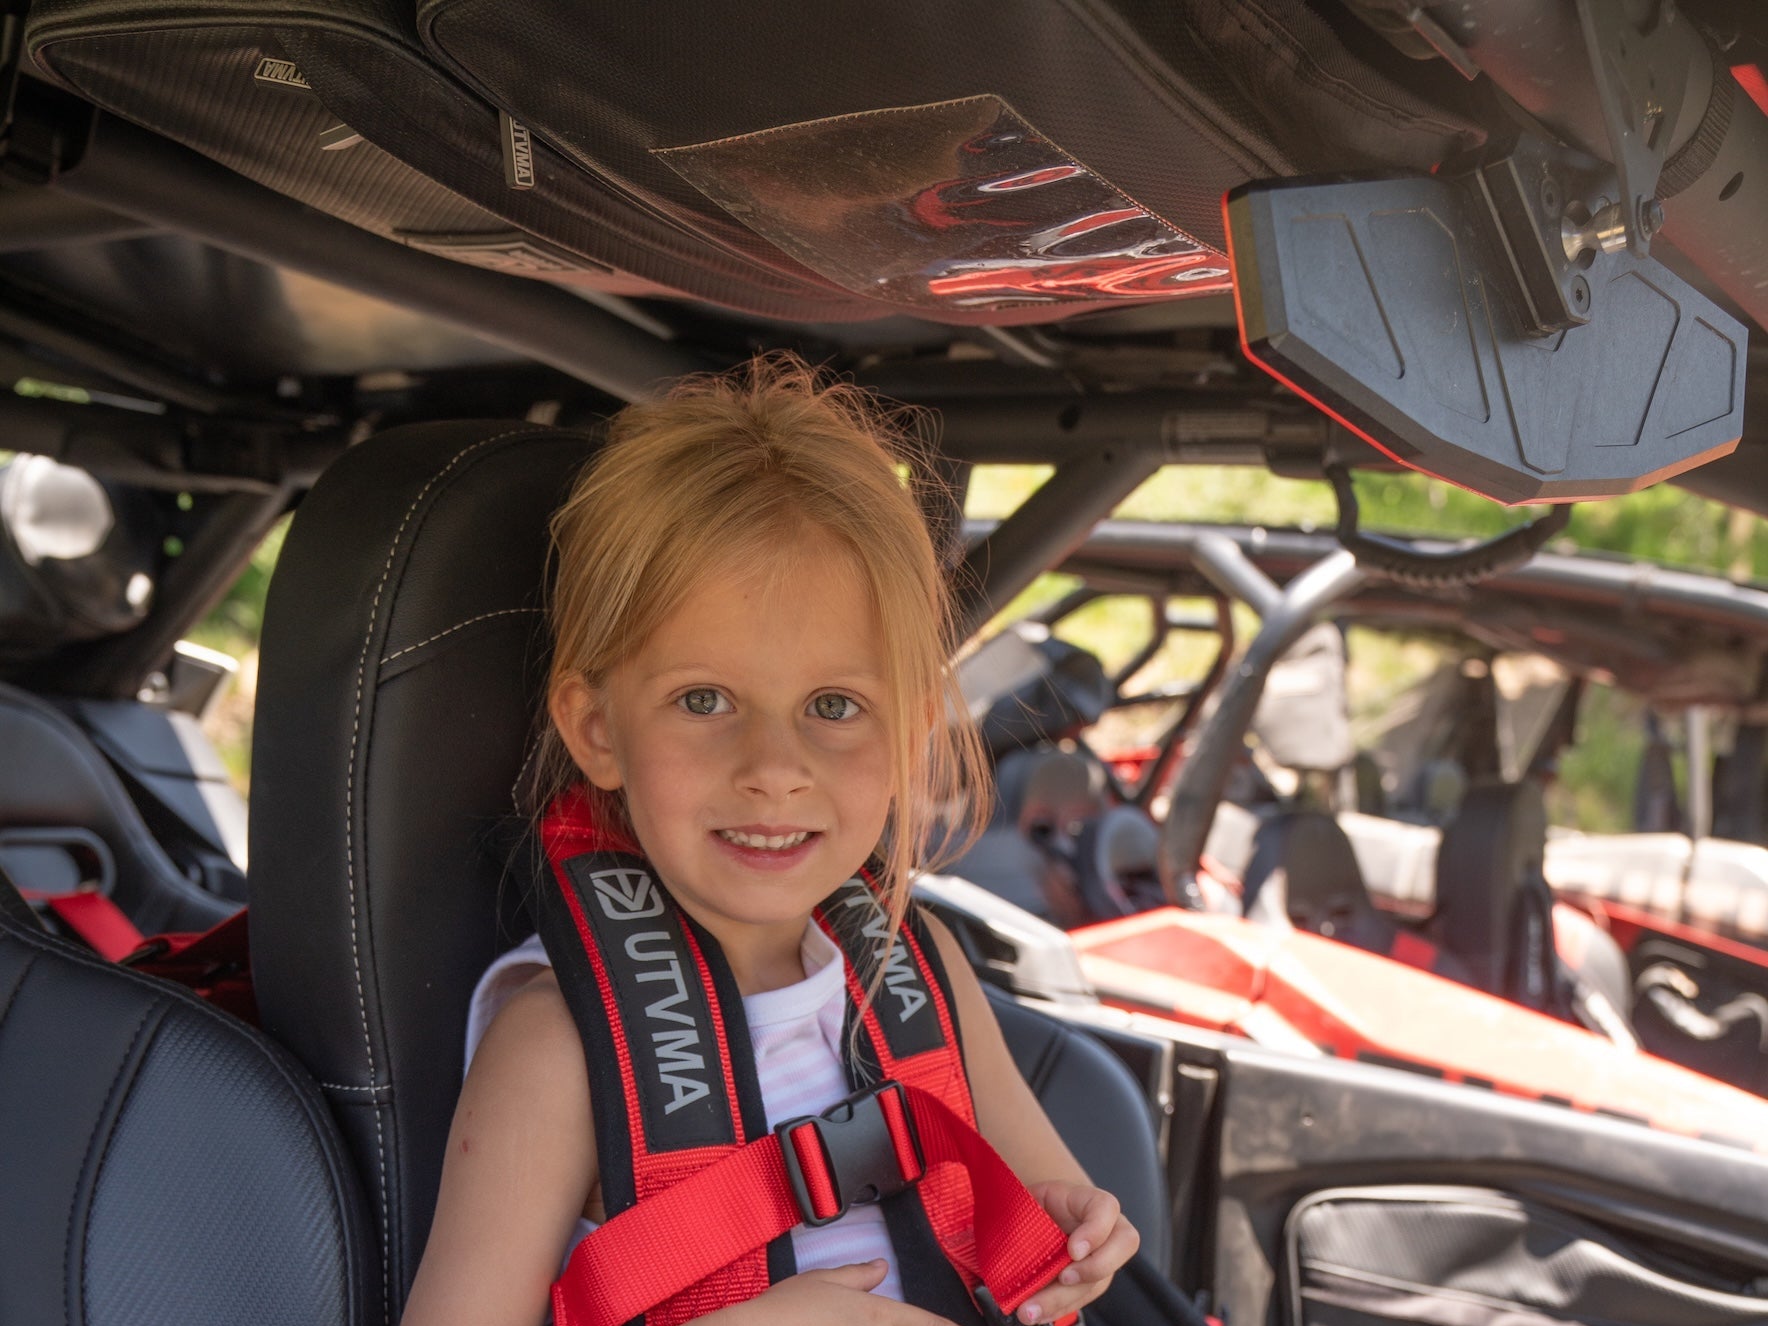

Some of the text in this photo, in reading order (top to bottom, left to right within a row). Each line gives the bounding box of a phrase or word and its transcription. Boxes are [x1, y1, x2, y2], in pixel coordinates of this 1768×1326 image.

[263, 61, 309, 85] TVMA
[624, 931, 710, 1115] UTVMA
[841, 878, 927, 1023] TVMA
